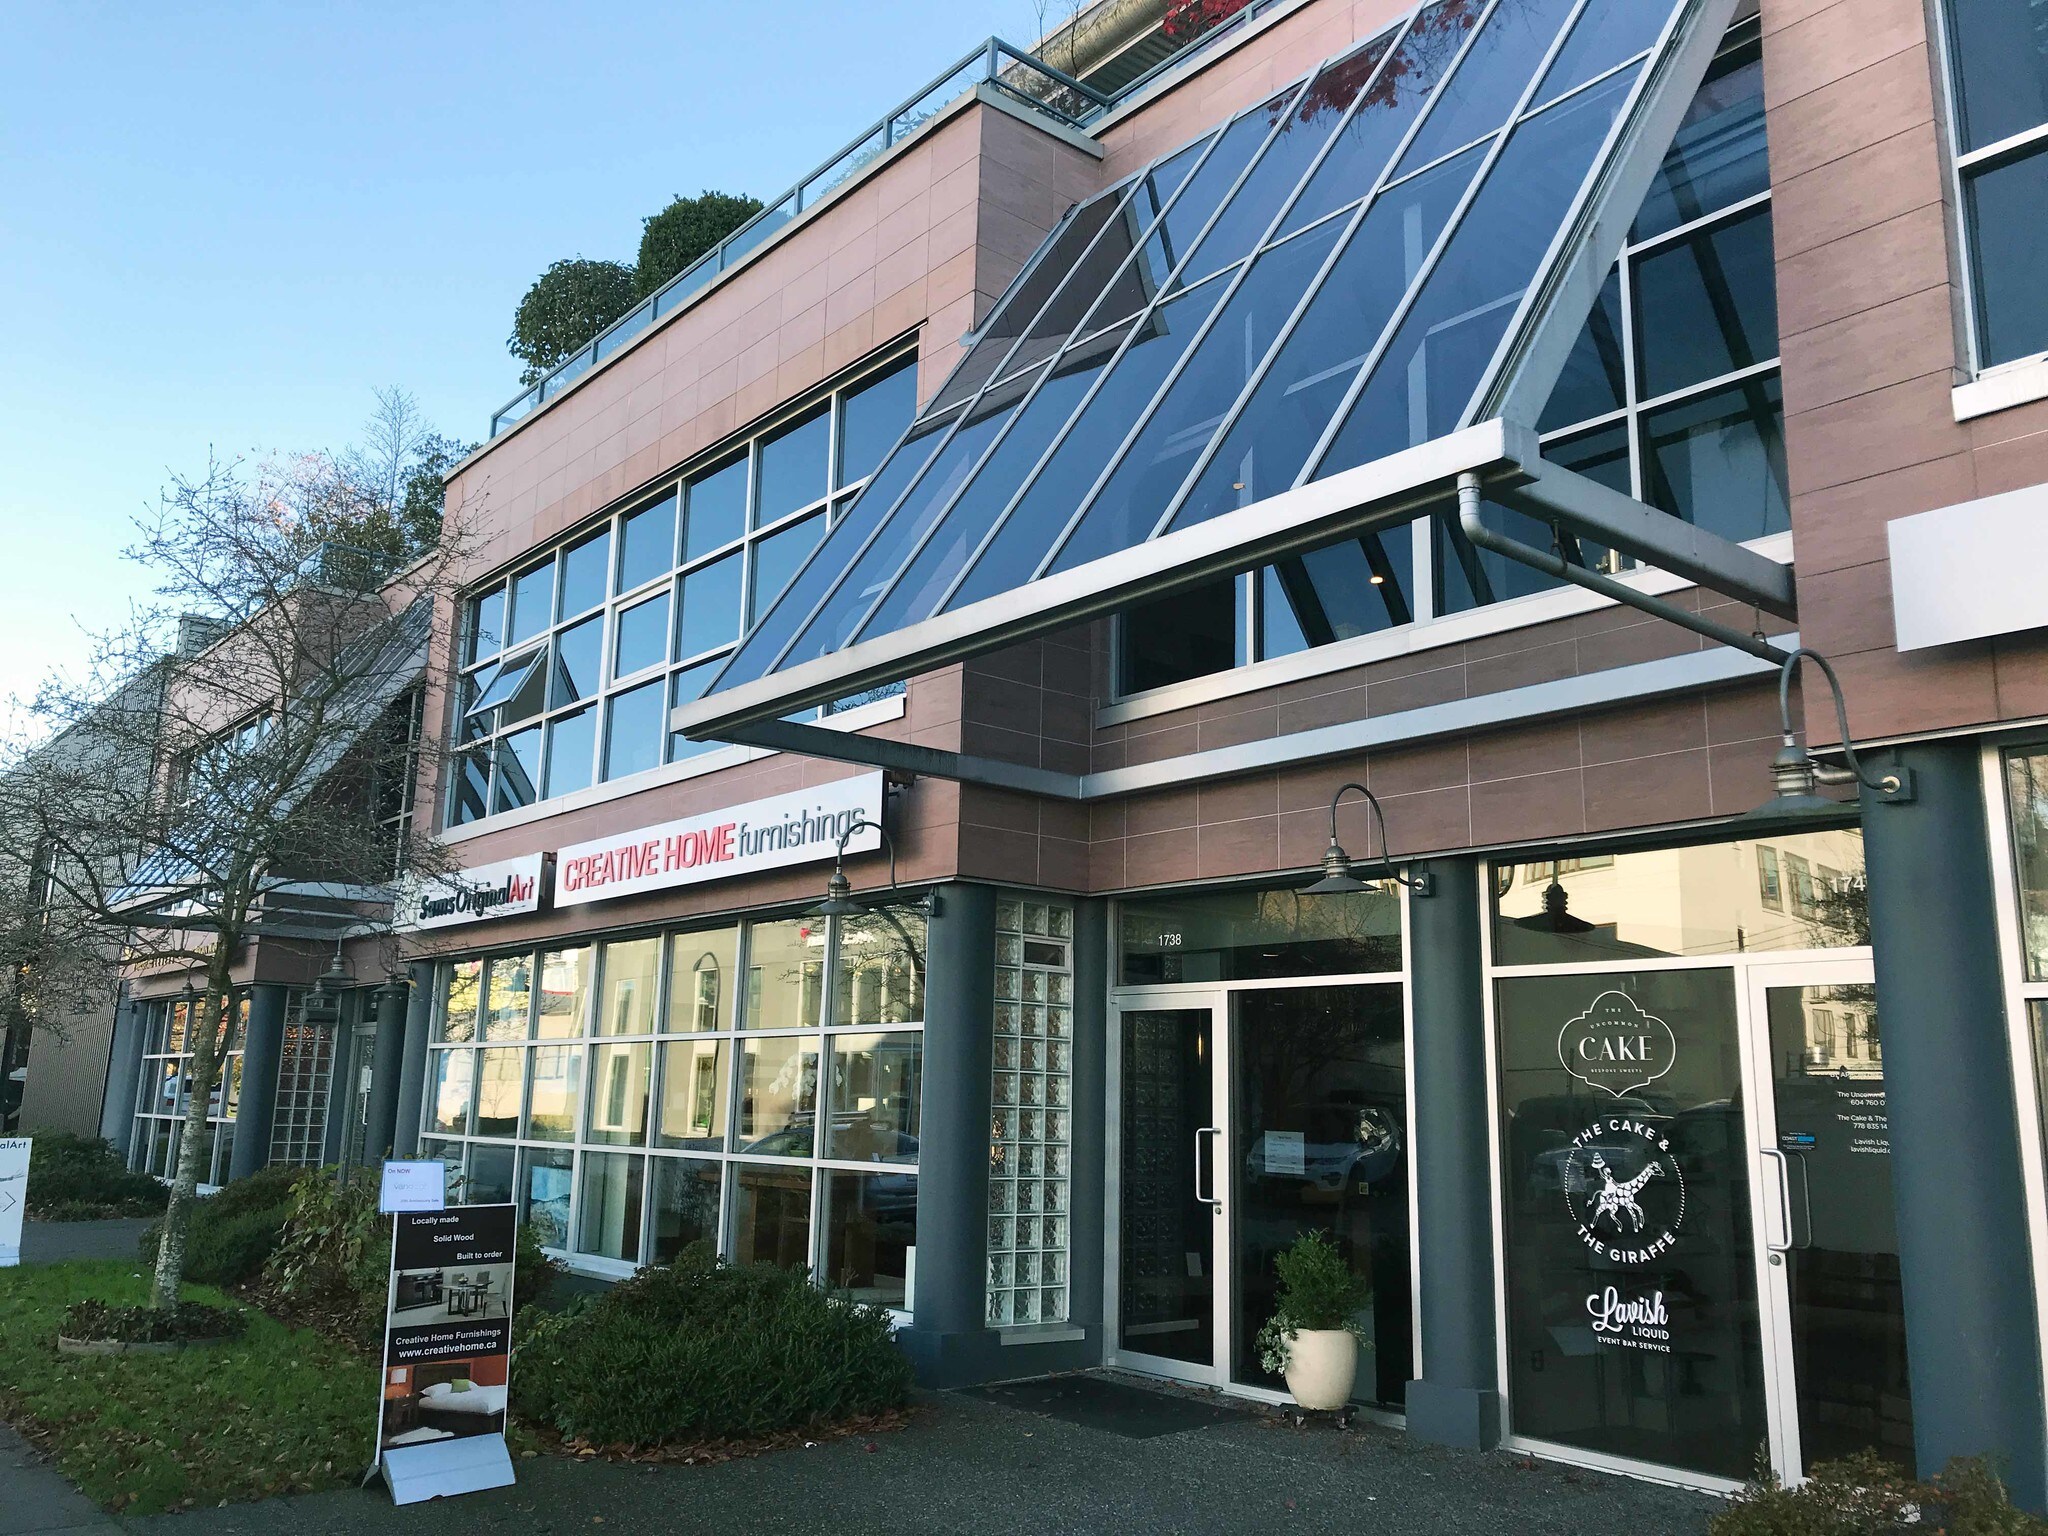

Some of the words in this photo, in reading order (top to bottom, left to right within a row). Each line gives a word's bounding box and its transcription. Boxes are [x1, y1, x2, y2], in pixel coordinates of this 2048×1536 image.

[564, 840, 660, 892] CREATIVE
[663, 822, 736, 872] HOME
[738, 806, 865, 857] furnishings
[1158, 933, 1182, 946] 1738
[1590, 1021, 1639, 1029] UNCOMMON
[1579, 1035, 1654, 1061] CAKE
[1572, 1123, 1603, 1148] THE
[1609, 1119, 1656, 1141] CAKE
[1658, 1138, 1670, 1152] &
[411, 1217, 438, 1225] Locally
[439, 1215, 460, 1223] made
[433, 1234, 453, 1243] Solid
[453, 1233, 475, 1241] Wood
[1577, 1224, 1605, 1255] THE
[1609, 1231, 1676, 1264] GIRAFFE
[456, 1252, 474, 1260] Built
[483, 1250, 503, 1258] order
[1586, 1286, 1669, 1333] Lavish
[395, 1335, 429, 1346] Creative
[430, 1332, 455, 1342] Home
[455, 1328, 502, 1340] Furnishings
[1631, 1326, 1670, 1340] LIQUID
[398, 1341, 497, 1358] www.creativehome.ca
[1597, 1335, 1621, 1346] EVENT
[1622, 1340, 1637, 1348] BAR
[1638, 1341, 1671, 1353] SERVICE
